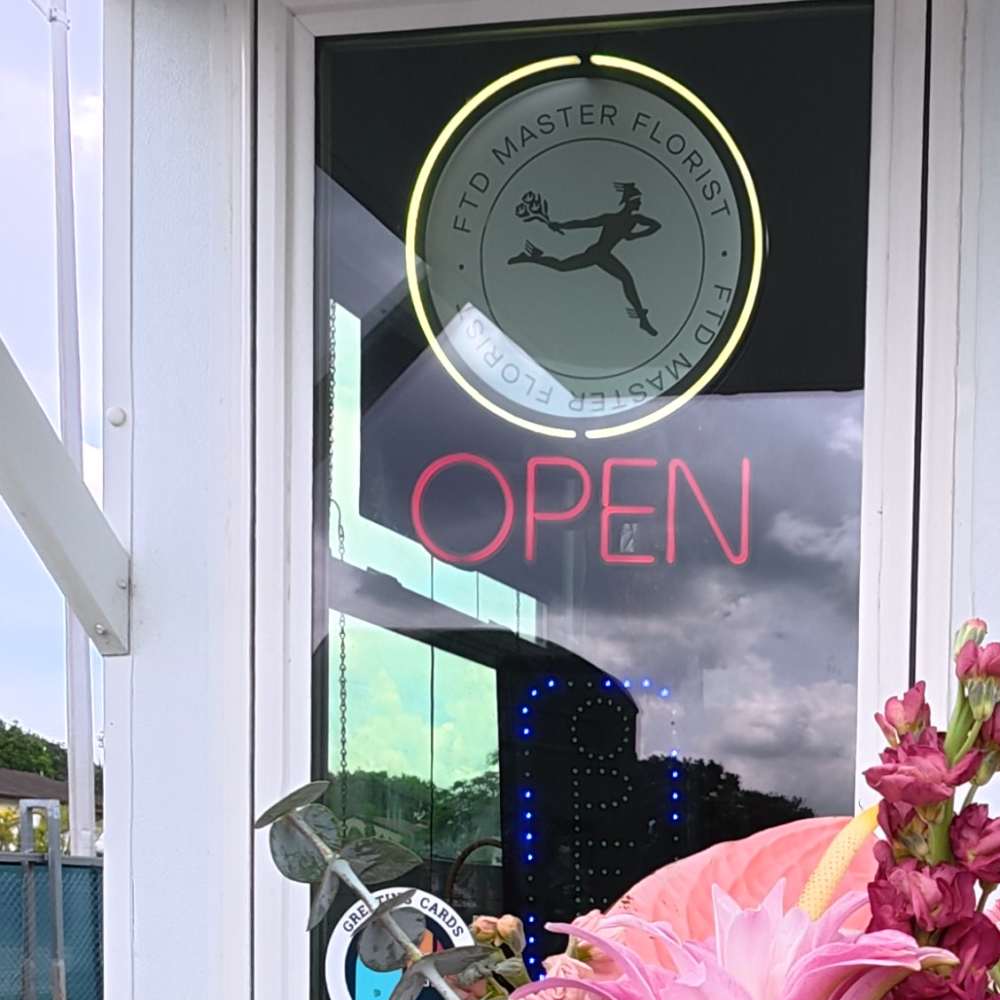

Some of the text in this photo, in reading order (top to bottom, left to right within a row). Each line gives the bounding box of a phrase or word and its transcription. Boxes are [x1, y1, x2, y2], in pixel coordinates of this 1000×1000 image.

[453, 104, 731, 233] FTD MASTER FLORIST
[694, 283, 732, 345] FTD
[568, 352, 692, 413] MASTER
[411, 452, 750, 566] OPEN
[570, 698, 636, 917] OPE
[420, 897, 464, 938] CARDS
